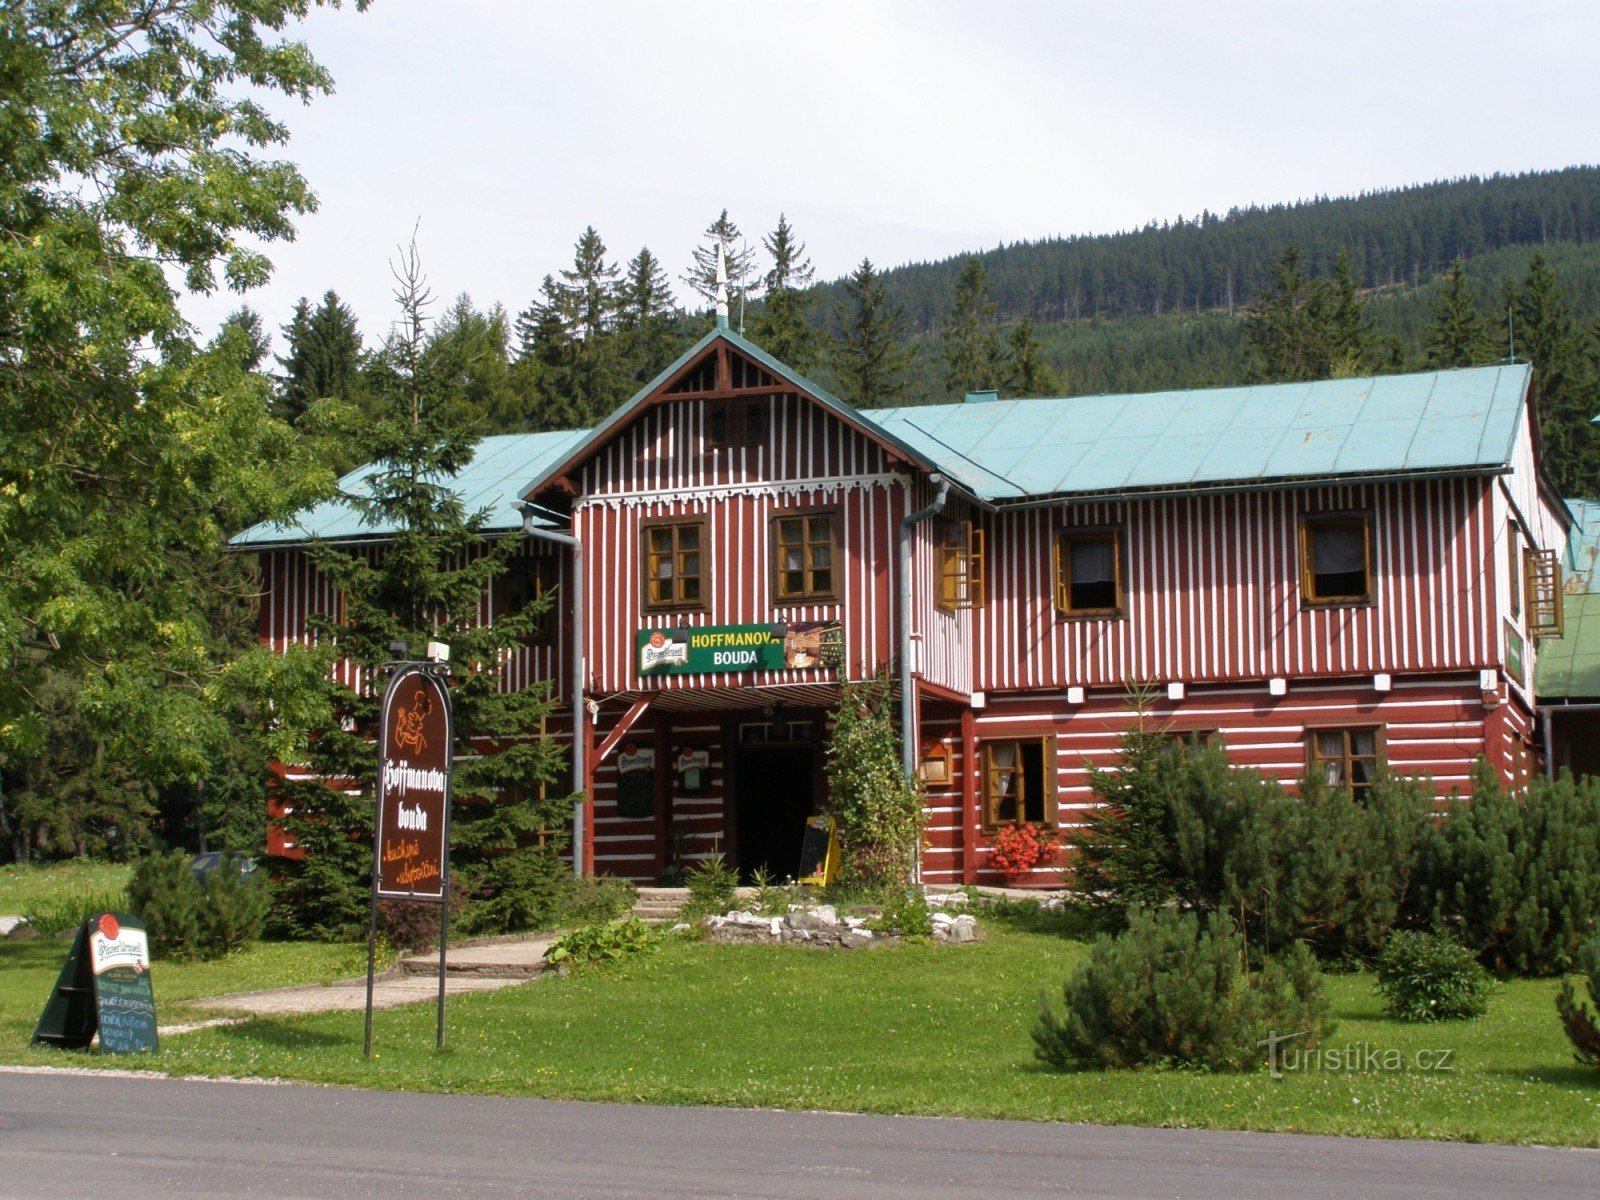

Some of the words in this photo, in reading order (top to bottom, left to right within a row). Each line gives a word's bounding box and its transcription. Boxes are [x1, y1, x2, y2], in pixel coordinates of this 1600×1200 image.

[713, 650, 758, 665] BOUDA
[384, 759, 444, 796] Hoffmanova
[398, 801, 427, 831] bouda
